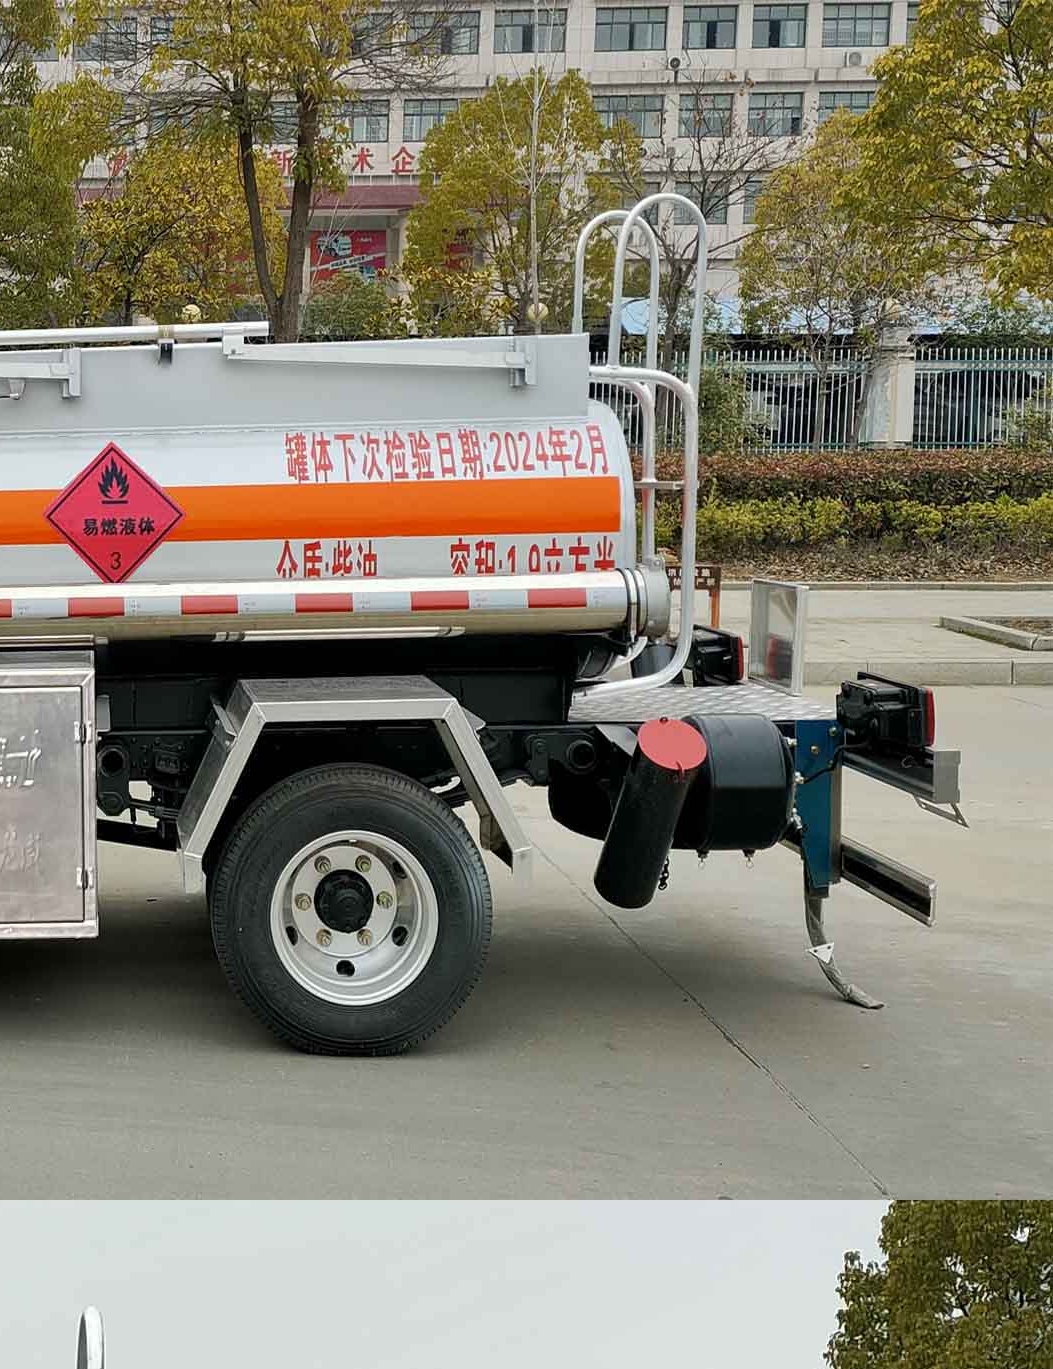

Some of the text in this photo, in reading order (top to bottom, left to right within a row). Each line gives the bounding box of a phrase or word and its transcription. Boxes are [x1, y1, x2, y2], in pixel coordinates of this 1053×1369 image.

[83, 517, 156, 537] 易燃液体
[110, 551, 122, 571] 3
